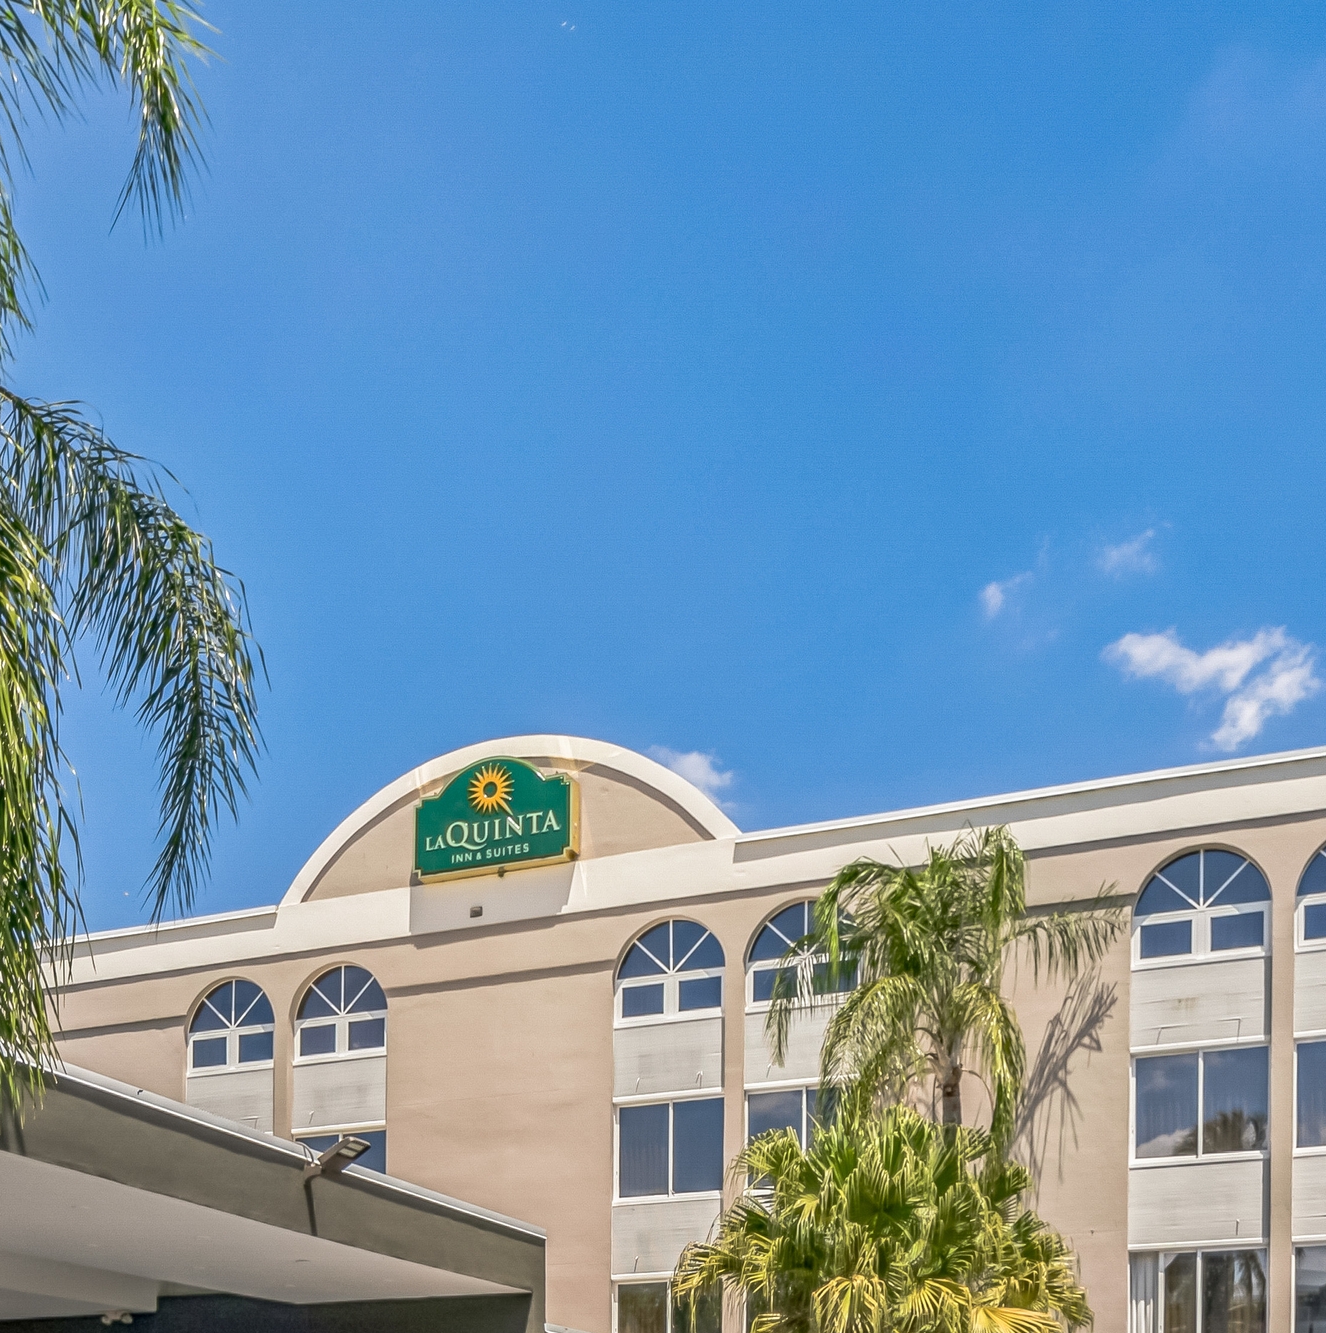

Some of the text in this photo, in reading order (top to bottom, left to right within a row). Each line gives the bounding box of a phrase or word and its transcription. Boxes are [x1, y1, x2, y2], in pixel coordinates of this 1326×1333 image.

[425, 809, 561, 852] LA QUINTA
[451, 852, 472, 864] INN
[486, 843, 530, 859] SUITES
